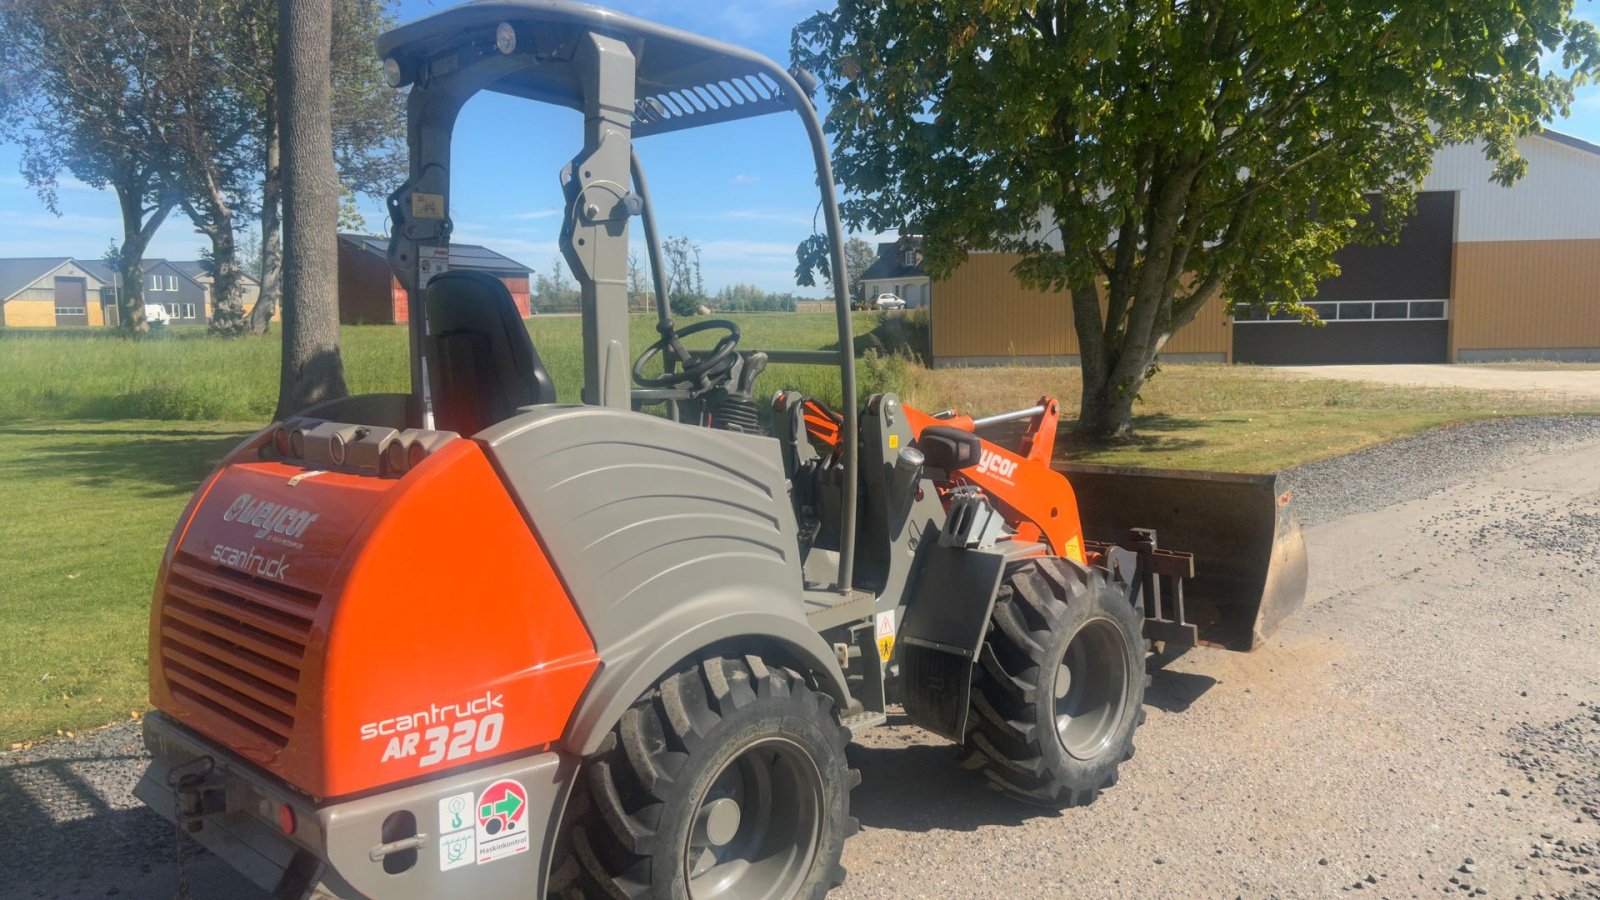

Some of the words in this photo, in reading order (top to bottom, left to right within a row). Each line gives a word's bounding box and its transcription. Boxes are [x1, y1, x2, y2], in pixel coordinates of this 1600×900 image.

[976, 449, 1018, 478] ycor
[237, 499, 320, 539] weycor
[210, 544, 290, 580] scantruck
[360, 691, 504, 740] scantruck
[380, 732, 420, 763] AR
[418, 713, 504, 768] 320
[479, 836, 527, 855] Maskinkontrol
